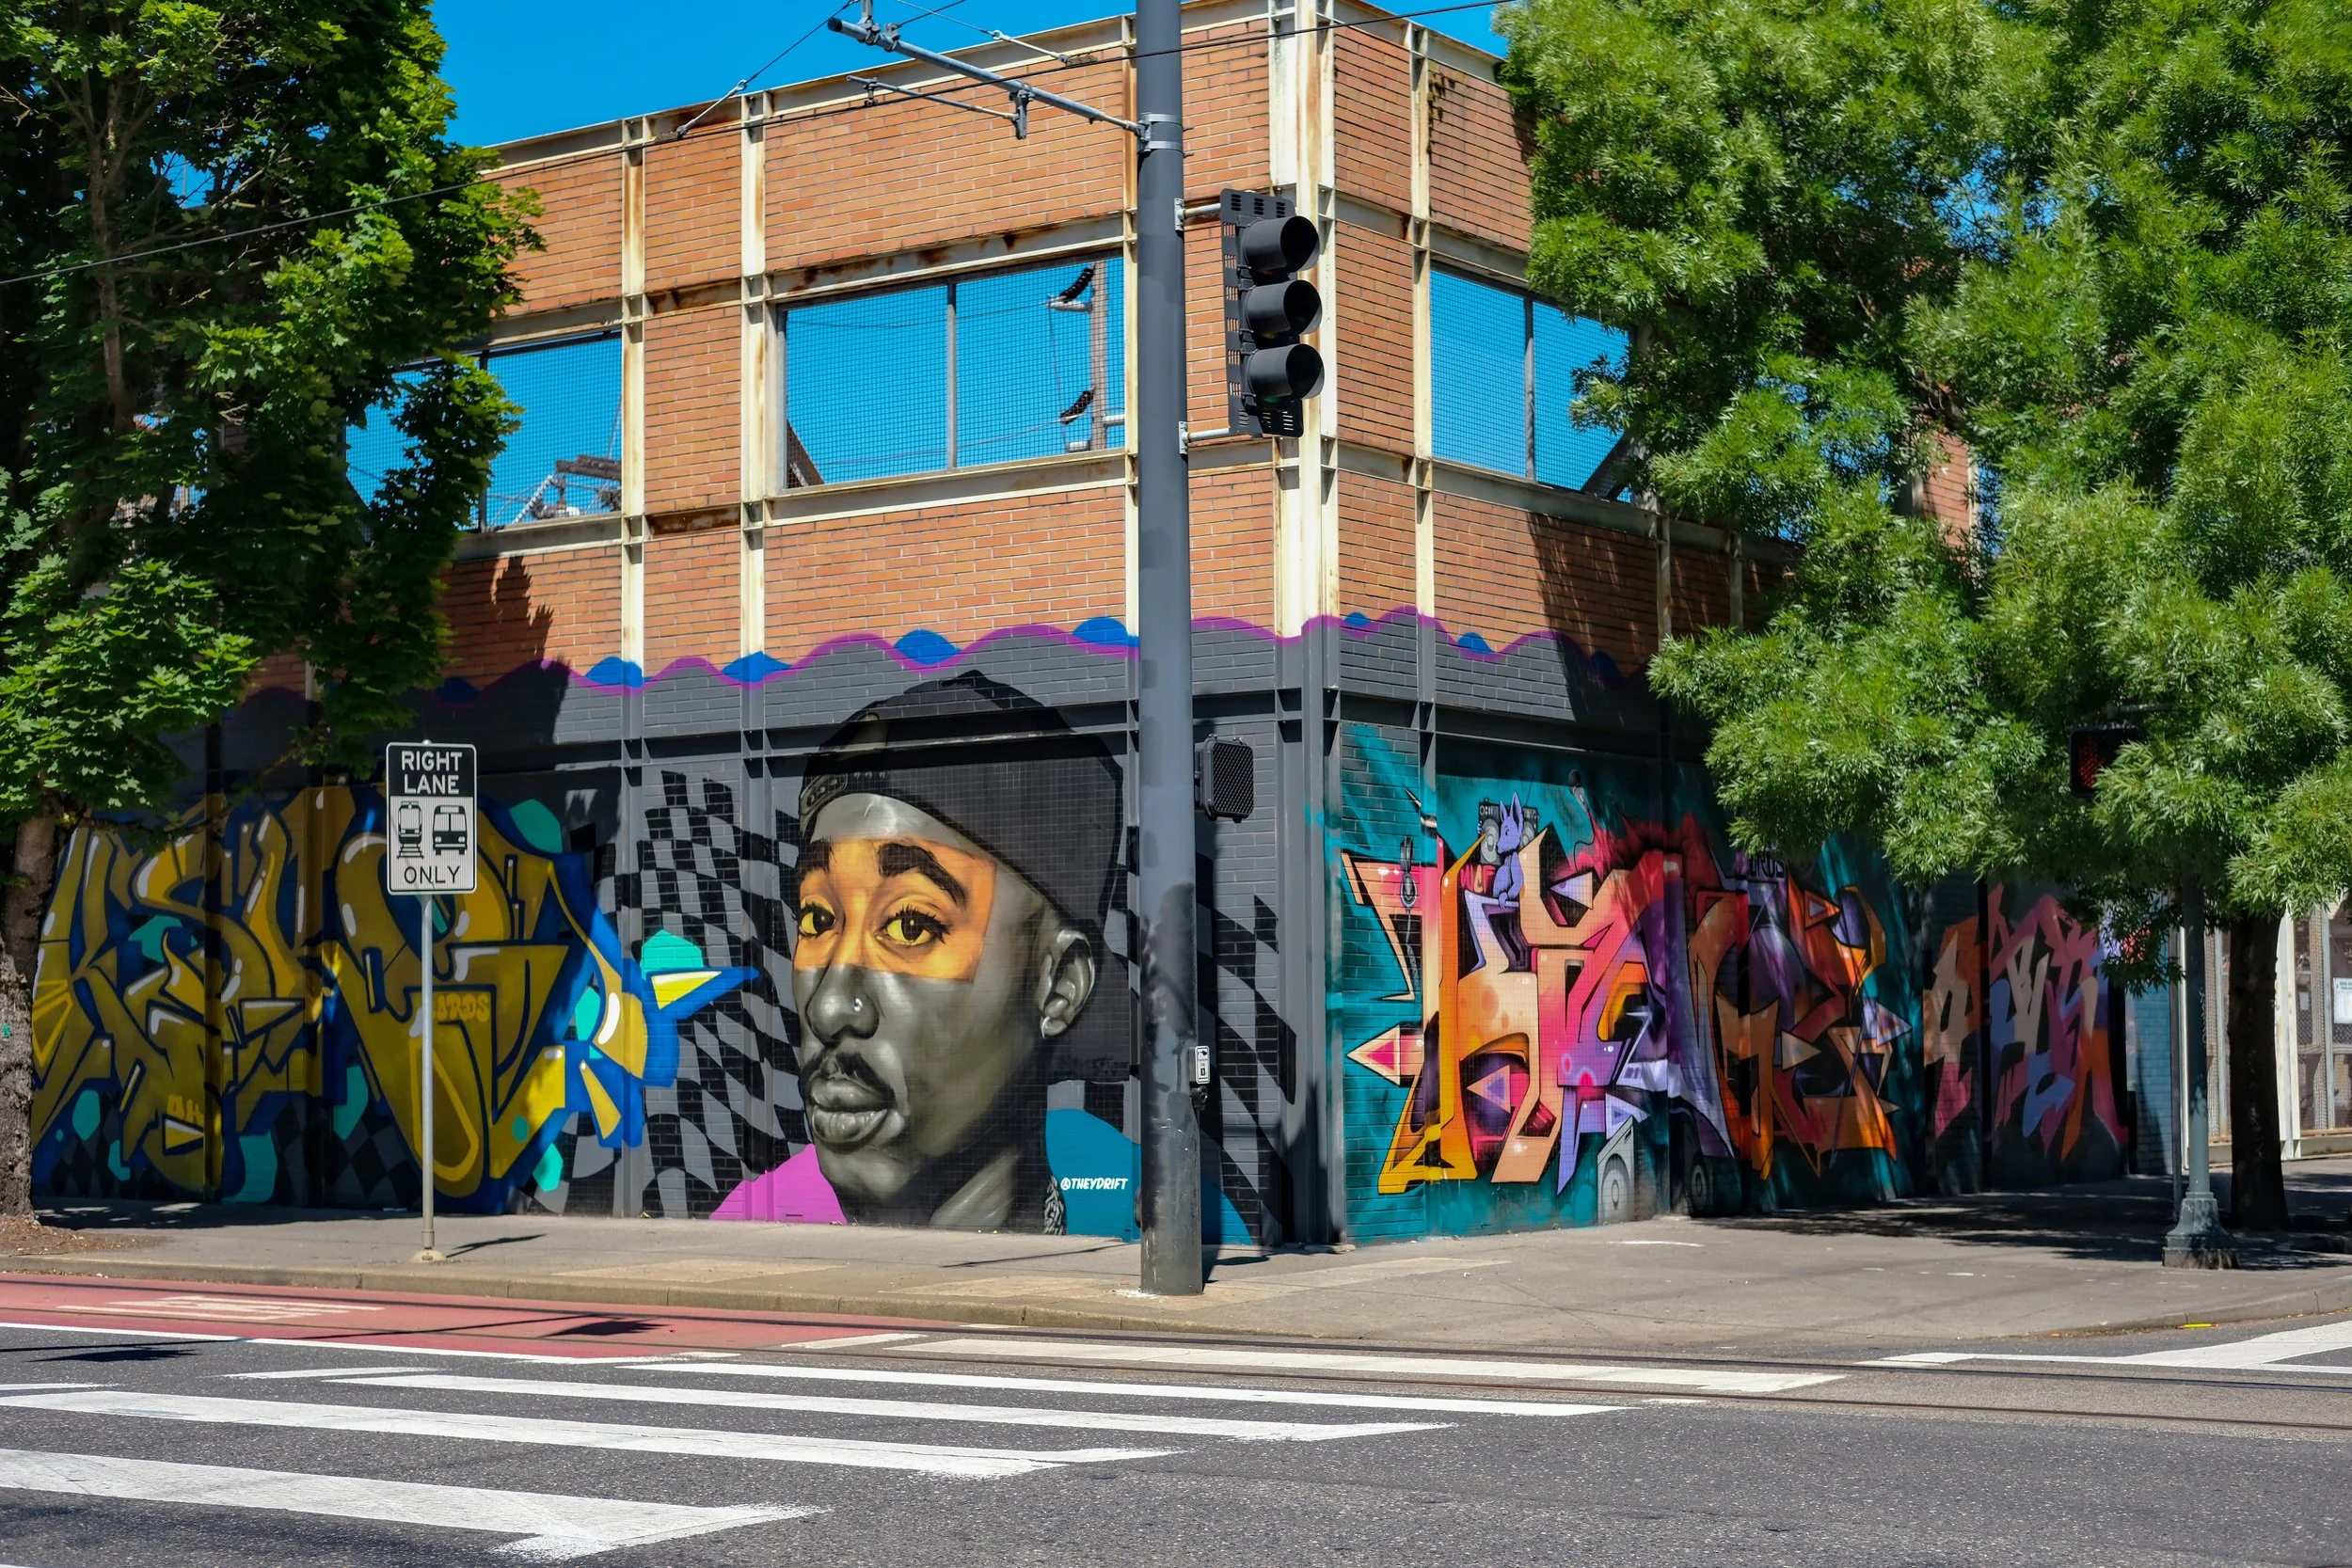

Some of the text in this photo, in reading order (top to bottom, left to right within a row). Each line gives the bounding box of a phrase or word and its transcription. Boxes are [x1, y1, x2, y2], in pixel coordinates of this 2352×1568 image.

[401, 751, 463, 772] RIGHT
[404, 774, 460, 795] LANE
[404, 865, 461, 884] ONLY
[1060, 1177, 1128, 1191] @THEYDRIFT
